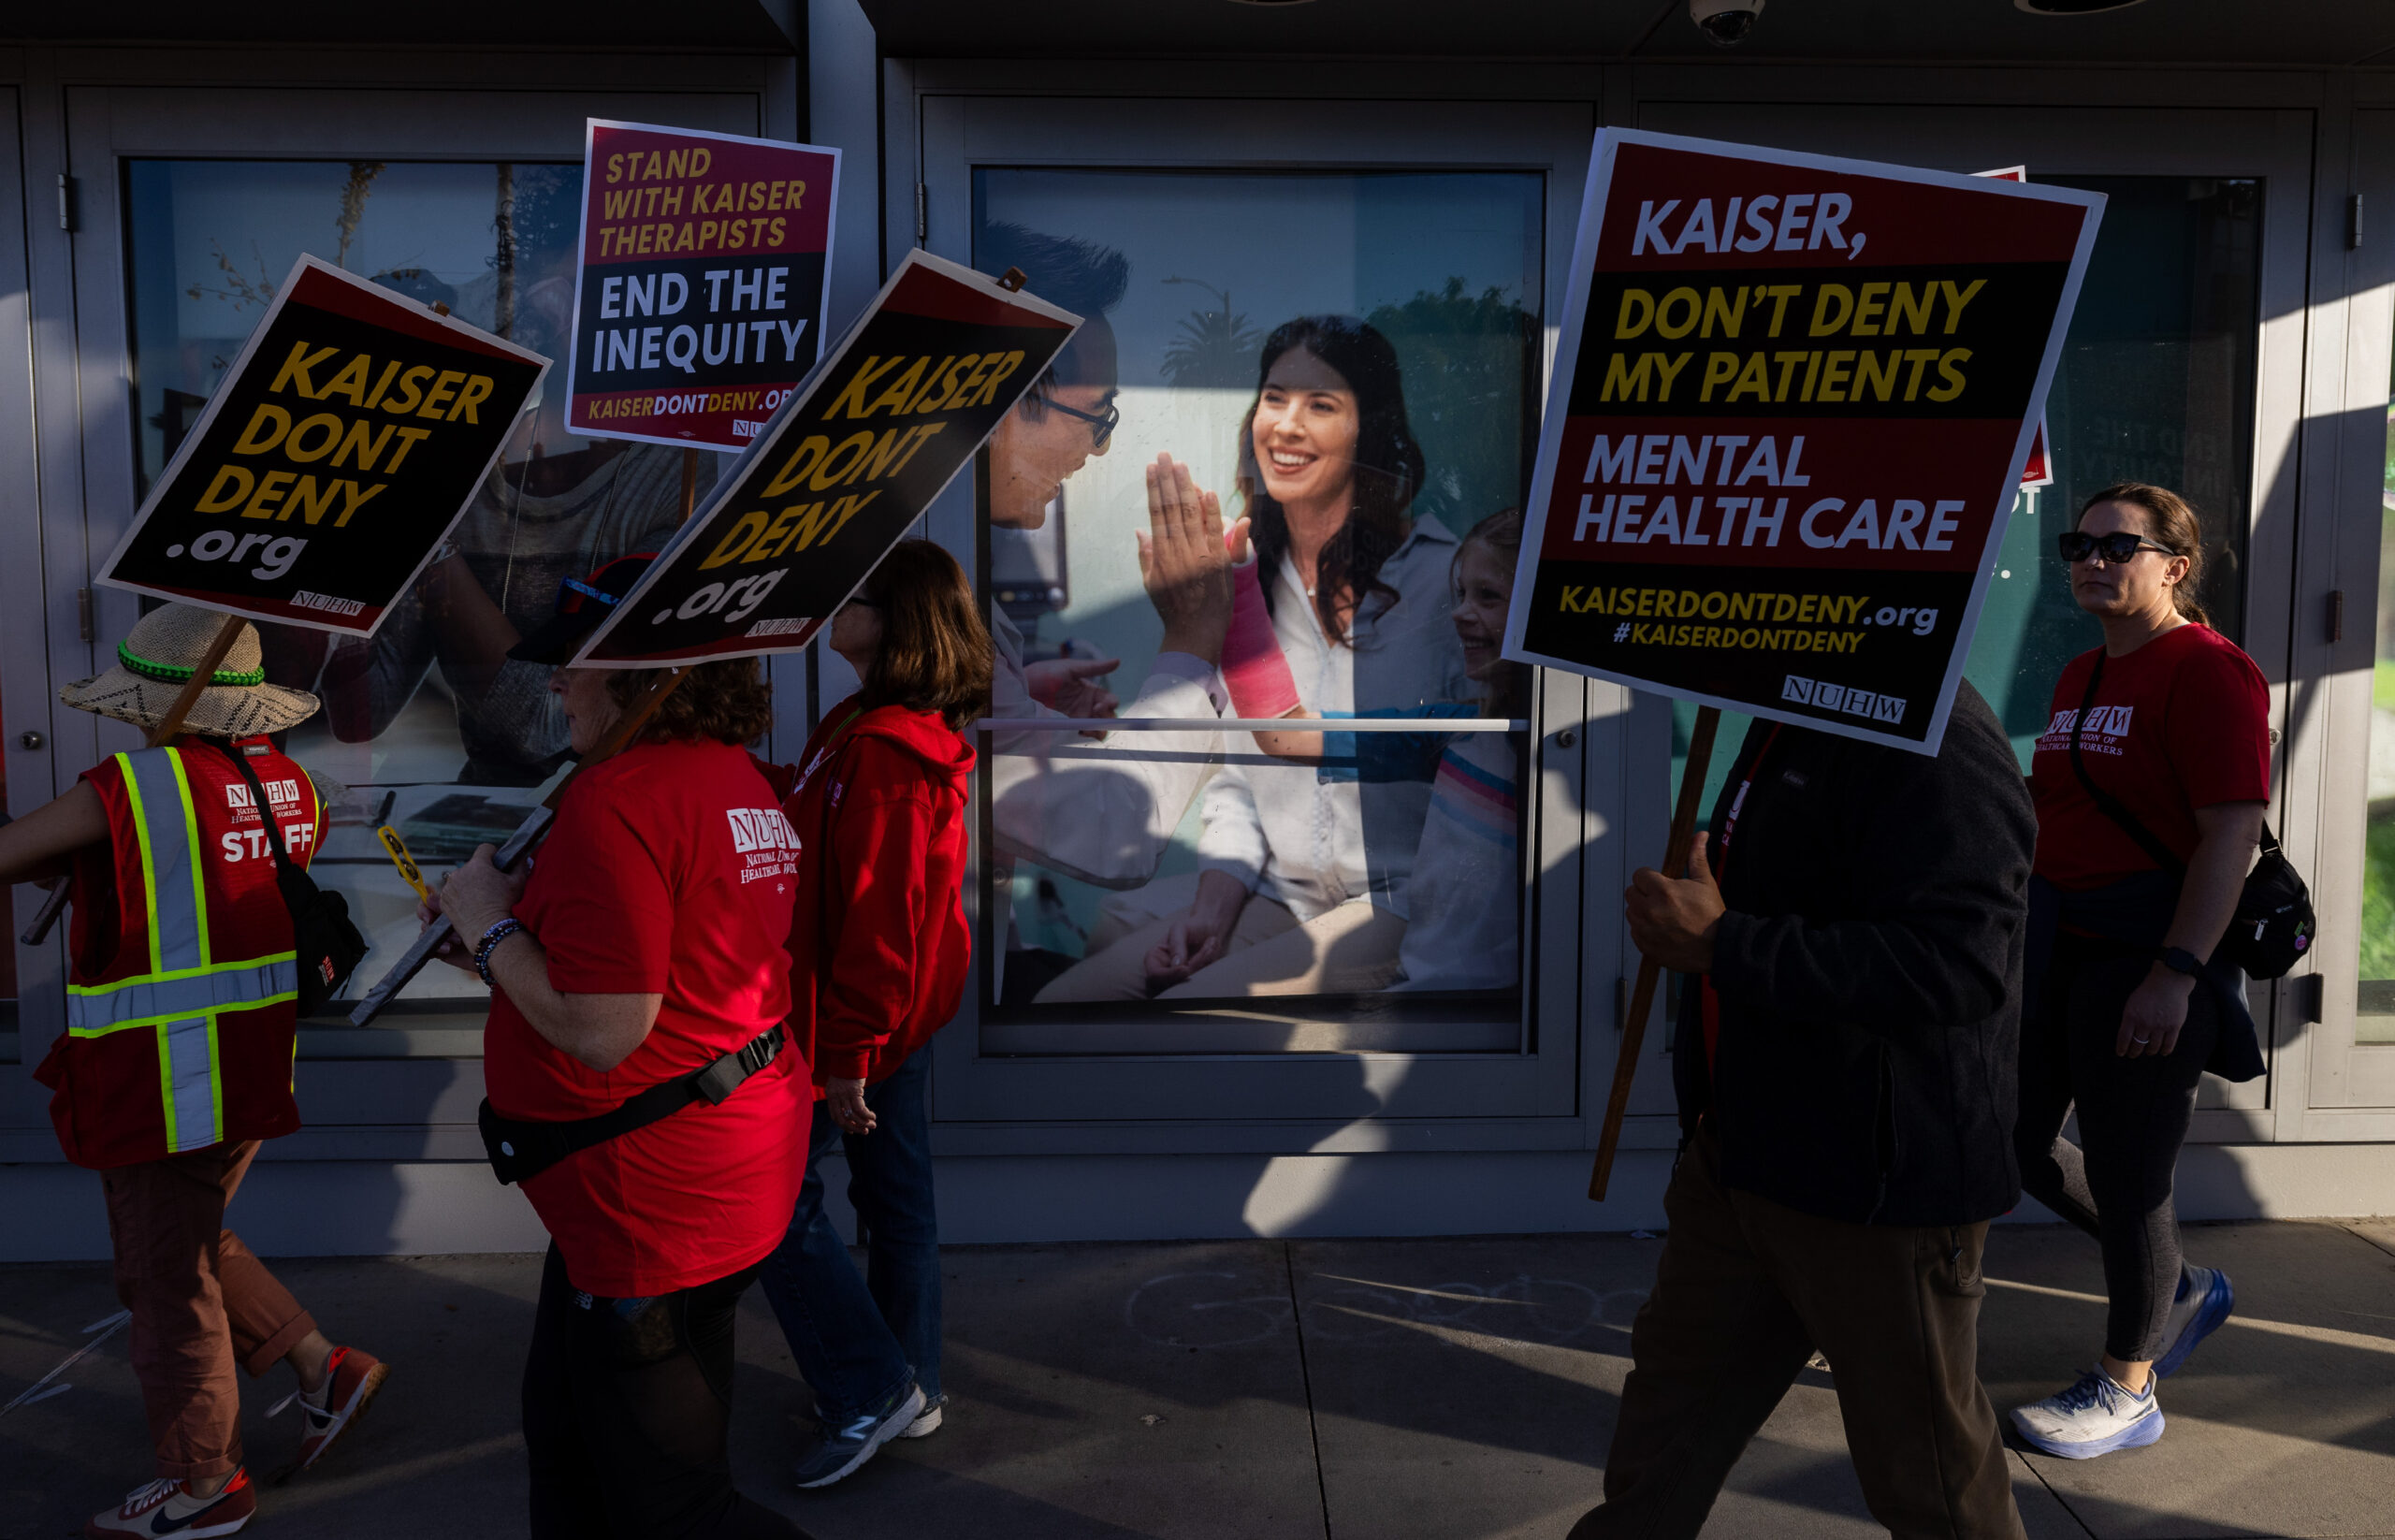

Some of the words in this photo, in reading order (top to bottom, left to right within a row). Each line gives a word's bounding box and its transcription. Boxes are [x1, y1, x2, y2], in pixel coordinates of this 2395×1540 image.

[605, 147, 712, 183] STAND
[603, 186, 685, 221] WITH
[690, 180, 807, 215] KAISER
[1631, 191, 1867, 261] KAISER,
[599, 216, 788, 257] THERAPISTS
[600, 271, 689, 320] END
[704, 266, 790, 313] THE
[1615, 284, 1802, 340] DON'T
[1807, 279, 1988, 337] DENY
[592, 318, 809, 373] INEQUITY
[269, 341, 494, 425] KAISER
[820, 350, 1025, 420] KAISER
[1600, 352, 1692, 402] MY
[1699, 347, 1974, 402] PATIENTS
[588, 389, 793, 420] KAISERDONTDENY.OR
[232, 403, 431, 474] DONT
[760, 422, 946, 498] DONT
[1583, 433, 1810, 487] MENTAL
[194, 464, 388, 528] DENY
[1574, 494, 1791, 547] HEALTH
[1798, 498, 1965, 552] CARE
[166, 530, 309, 581] .org
[697, 489, 882, 571] DENY
[288, 589, 367, 617] NUHW
[652, 567, 789, 623] .org
[1559, 585, 1939, 636] KAISERDONTDENY.org
[745, 617, 812, 638] NUHW
[1612, 622, 1866, 654] #KAISERDONTDENY
[1781, 675, 1908, 724] NUHW
[225, 778, 300, 808] NHW
